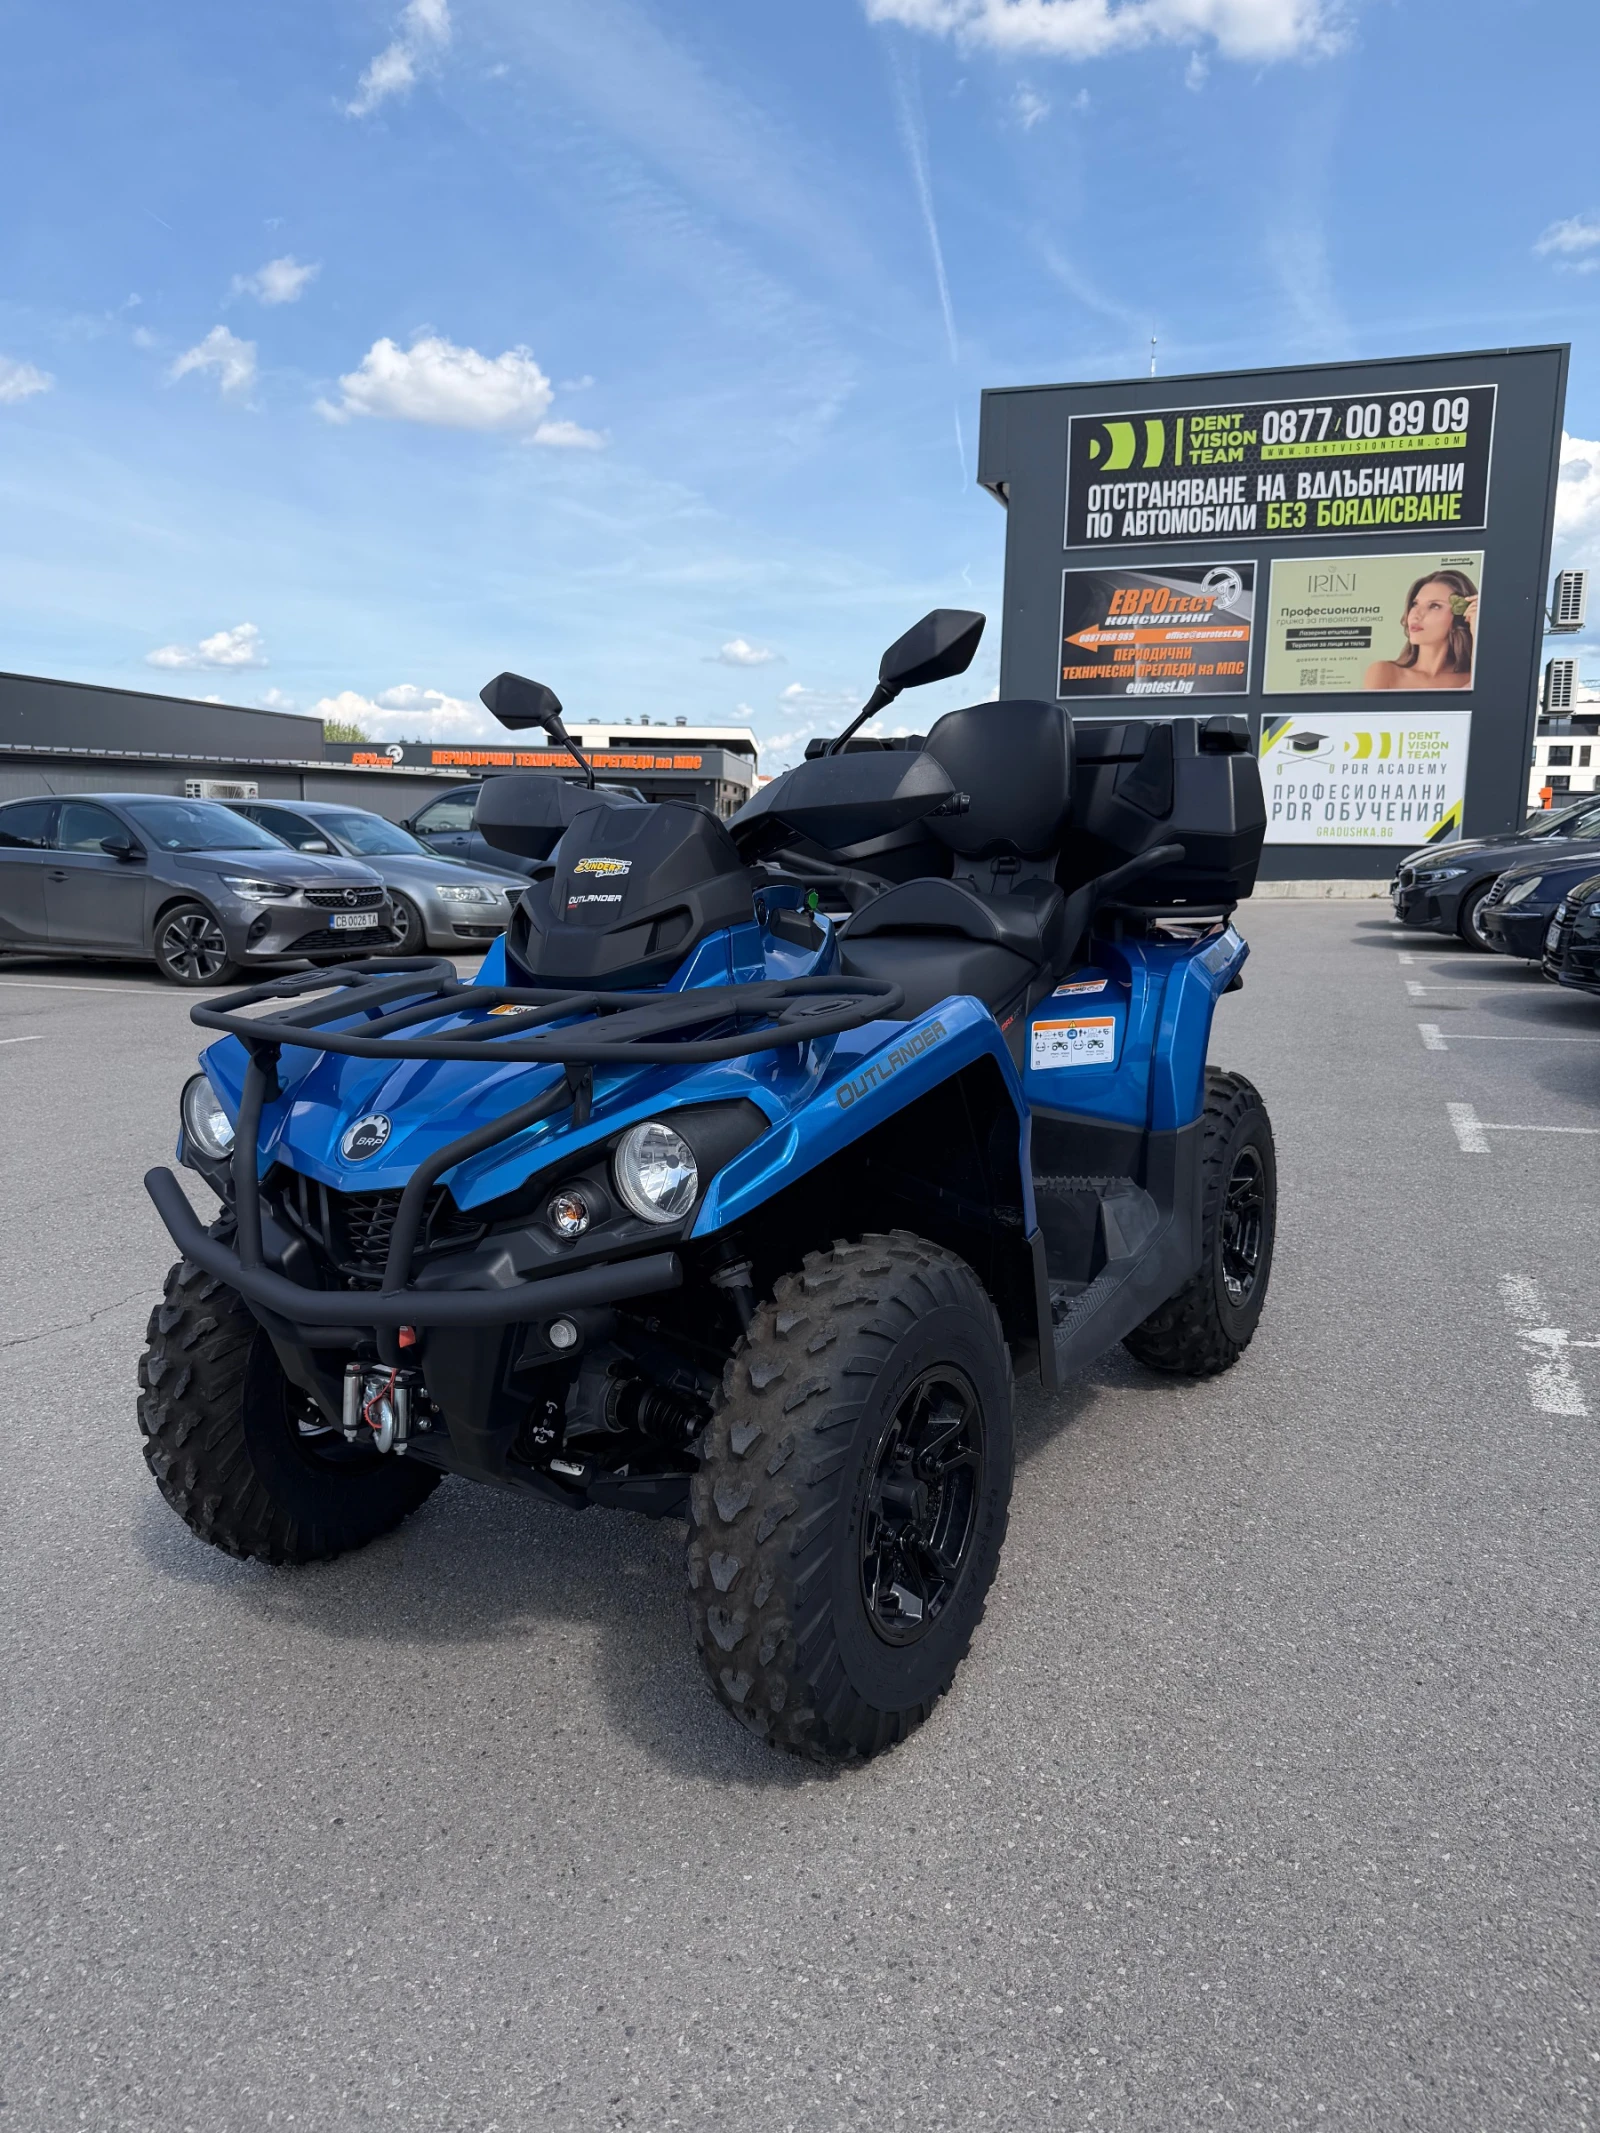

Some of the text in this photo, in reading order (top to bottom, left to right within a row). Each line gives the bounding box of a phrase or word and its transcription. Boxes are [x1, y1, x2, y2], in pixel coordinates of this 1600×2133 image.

[1190, 414, 1244, 432] DENT
[1262, 407, 1332, 445] 0877
[1345, 403, 1382, 439] 00
[1388, 400, 1425, 436] 89
[1432, 397, 1469, 433] 09
[1189, 429, 1257, 448] VISION
[1267, 436, 1460, 456] WWW.DENTVISIONTEAM.COM
[1189, 447, 1244, 466] TEAM
[1087, 462, 1465, 512] ОТСТРАНЯВАНЕ НА ВДЛЪБНАТИНИ
[1086, 493, 1463, 539] ПО АВТОМОБИЛИ БЕЗ БОЯДИСВАНЕ
[1308, 573, 1356, 593] IRINI
[1281, 606, 1380, 618] Професионална
[1113, 647, 1193, 662] ПЕРИОДИЧНИ
[1063, 661, 1245, 680] ТЕХНИЧЕСКИ ПРЕГЛЕДИ на МПС
[1126, 680, 1194, 695] eurotest.bg
[1408, 731, 1441, 740] DENT
[1407, 741, 1449, 750] VISION
[1407, 751, 1441, 760] TEAM
[1342, 763, 1448, 775] PDR ACADEMY
[1273, 782, 1446, 801] ПРОФЕСИОНАЛНИ
[1272, 802, 1445, 822] PDR ОБУЧЕНИЯ
[1316, 826, 1393, 838] GRADUSHKA.BG
[569, 894, 622, 904] OUTLANDER
[836, 1019, 948, 1111] OUTLANDER
[356, 1137, 383, 1147] BRP
